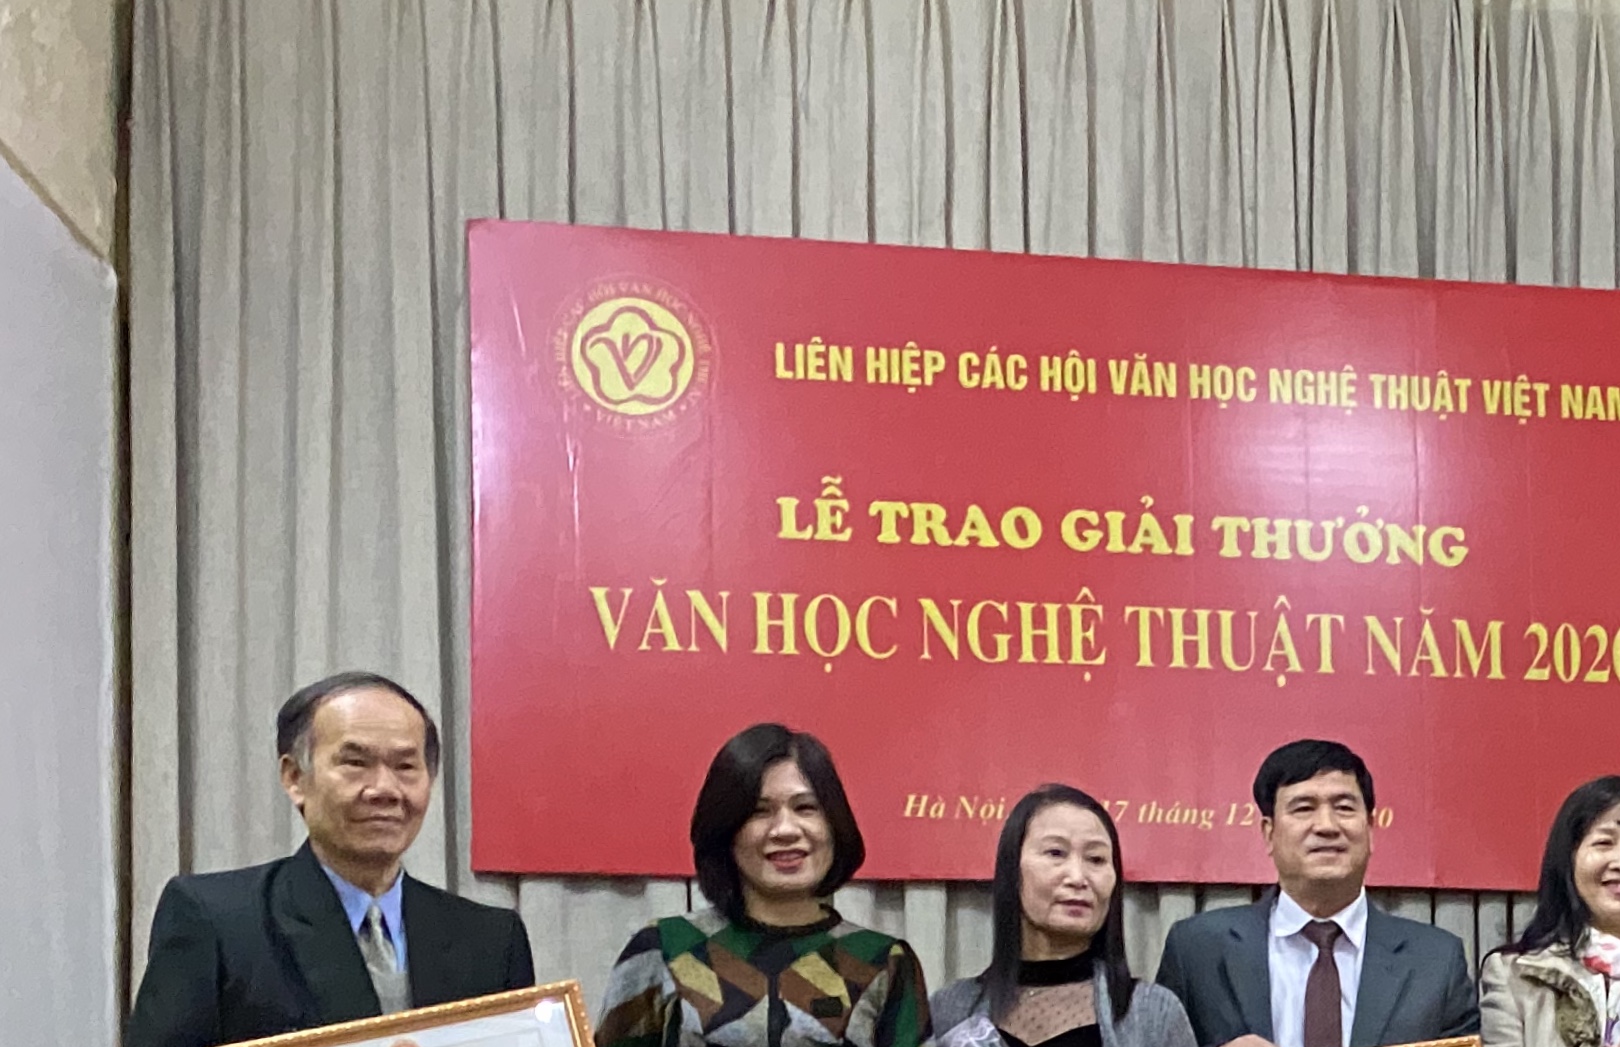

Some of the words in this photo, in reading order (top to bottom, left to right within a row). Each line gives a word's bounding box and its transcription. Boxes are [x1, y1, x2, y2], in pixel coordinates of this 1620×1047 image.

[775, 335, 855, 384] LIÊN
[865, 341, 948, 396] HIỆP
[957, 347, 1029, 394] CÁC
[1039, 350, 1099, 402] HỘI
[1108, 354, 1179, 400] VĂN
[1188, 364, 1258, 409] HỌC
[1270, 364, 1357, 414] NGHỆ
[1371, 369, 1473, 420] THUẬT
[1482, 371, 1552, 424] VIỆT
[776, 474, 854, 544] LỄ
[868, 500, 1044, 551] TRAO
[1059, 494, 1196, 557] GIẢI
[1211, 505, 1470, 570] THƯỞNG
[590, 577, 730, 654] VĂN
[752, 591, 900, 675] HỌC
[918, 585, 1108, 684] NGHỆ
[1125, 593, 1346, 689] THUẬT
[1363, 602, 1506, 683] NĂM
[903, 794, 946, 819] Hà
[956, 796, 1005, 826] Nội
[1137, 801, 1214, 830] tháng
[1226, 802, 1255, 826] 12
